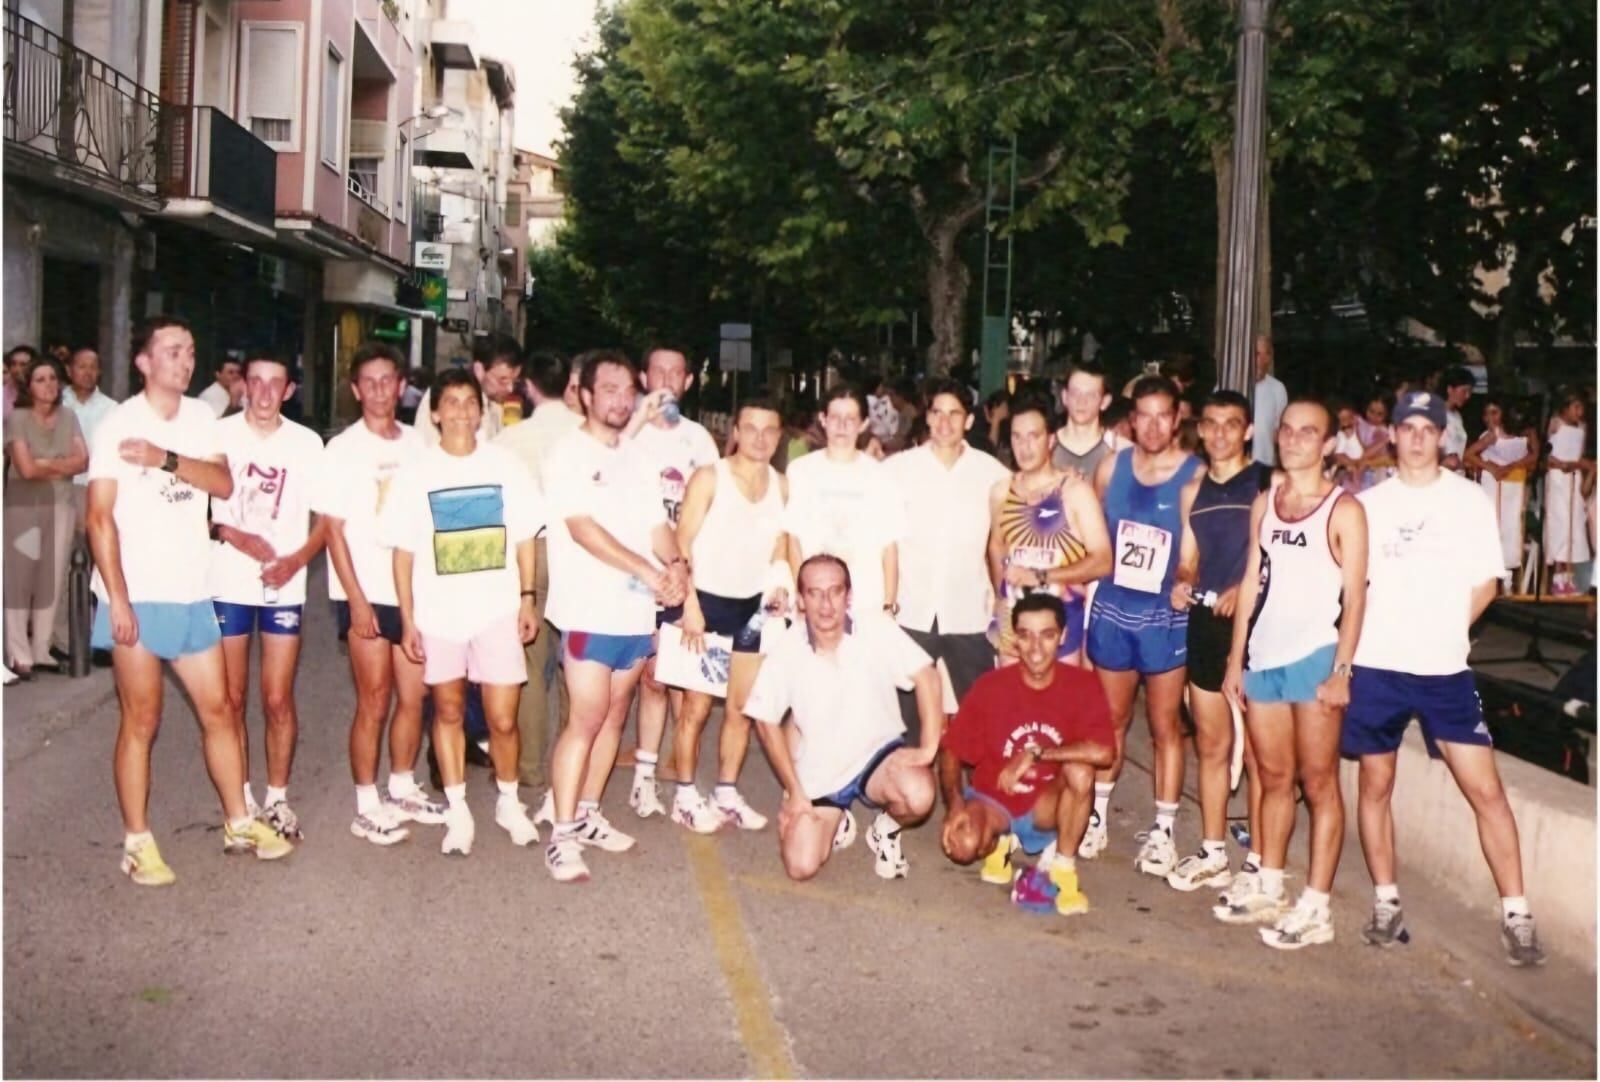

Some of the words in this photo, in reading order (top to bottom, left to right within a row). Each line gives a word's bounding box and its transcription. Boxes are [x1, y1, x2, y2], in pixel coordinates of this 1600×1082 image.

[247, 463, 278, 494] 29
[1271, 530, 1307, 547] FILA
[1120, 542, 1155, 571] 251
